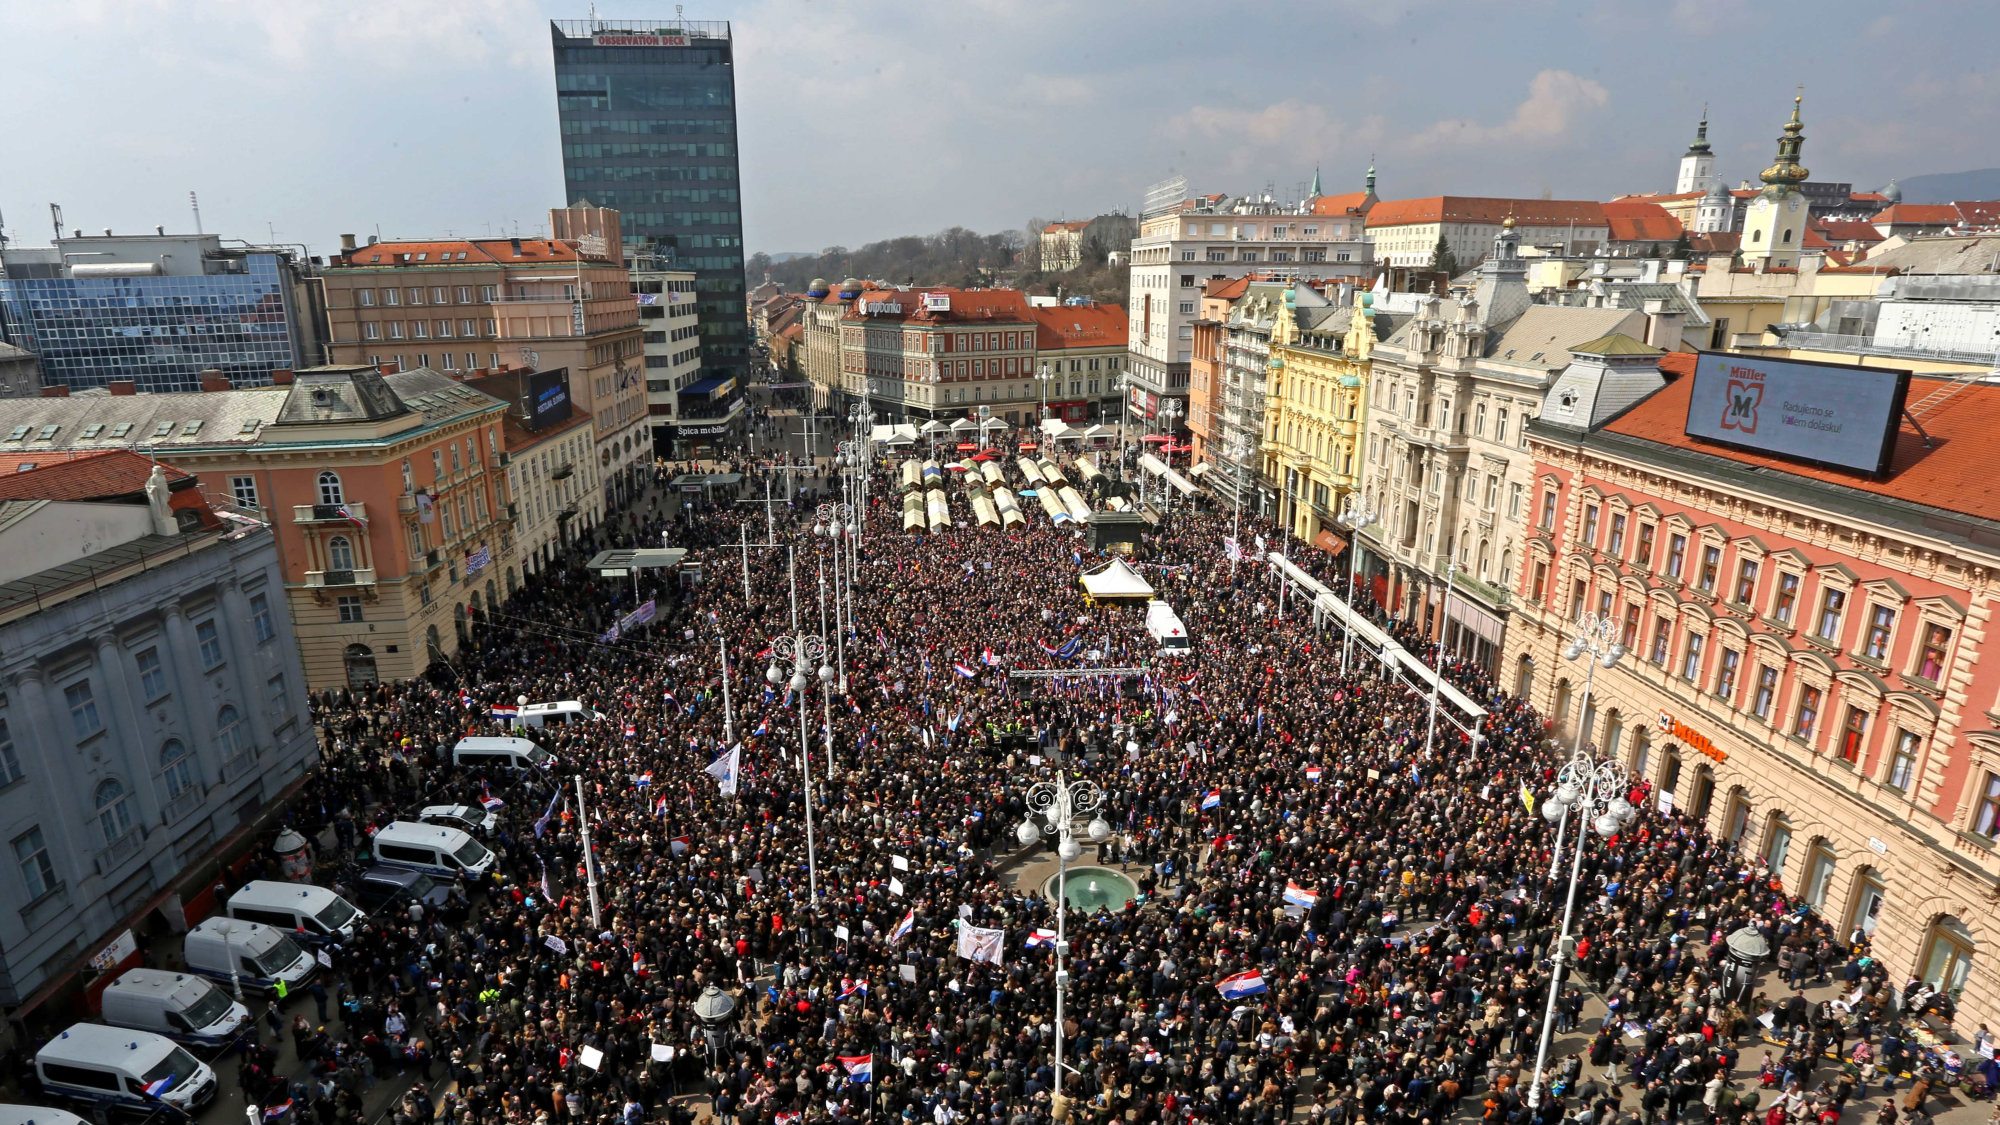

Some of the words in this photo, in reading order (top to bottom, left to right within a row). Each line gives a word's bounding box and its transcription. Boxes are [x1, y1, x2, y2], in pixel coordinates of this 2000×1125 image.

[598, 36, 659, 46] OBSERVATION
[662, 36, 685, 46] DECK
[1730, 366, 1767, 381] Müller
[1731, 395, 1753, 418] M
[1782, 401, 1823, 417] Radujemo
[1824, 409, 1835, 418] se
[419, 601, 439, 620] SINGER
[1672, 719, 1729, 764] Müller
